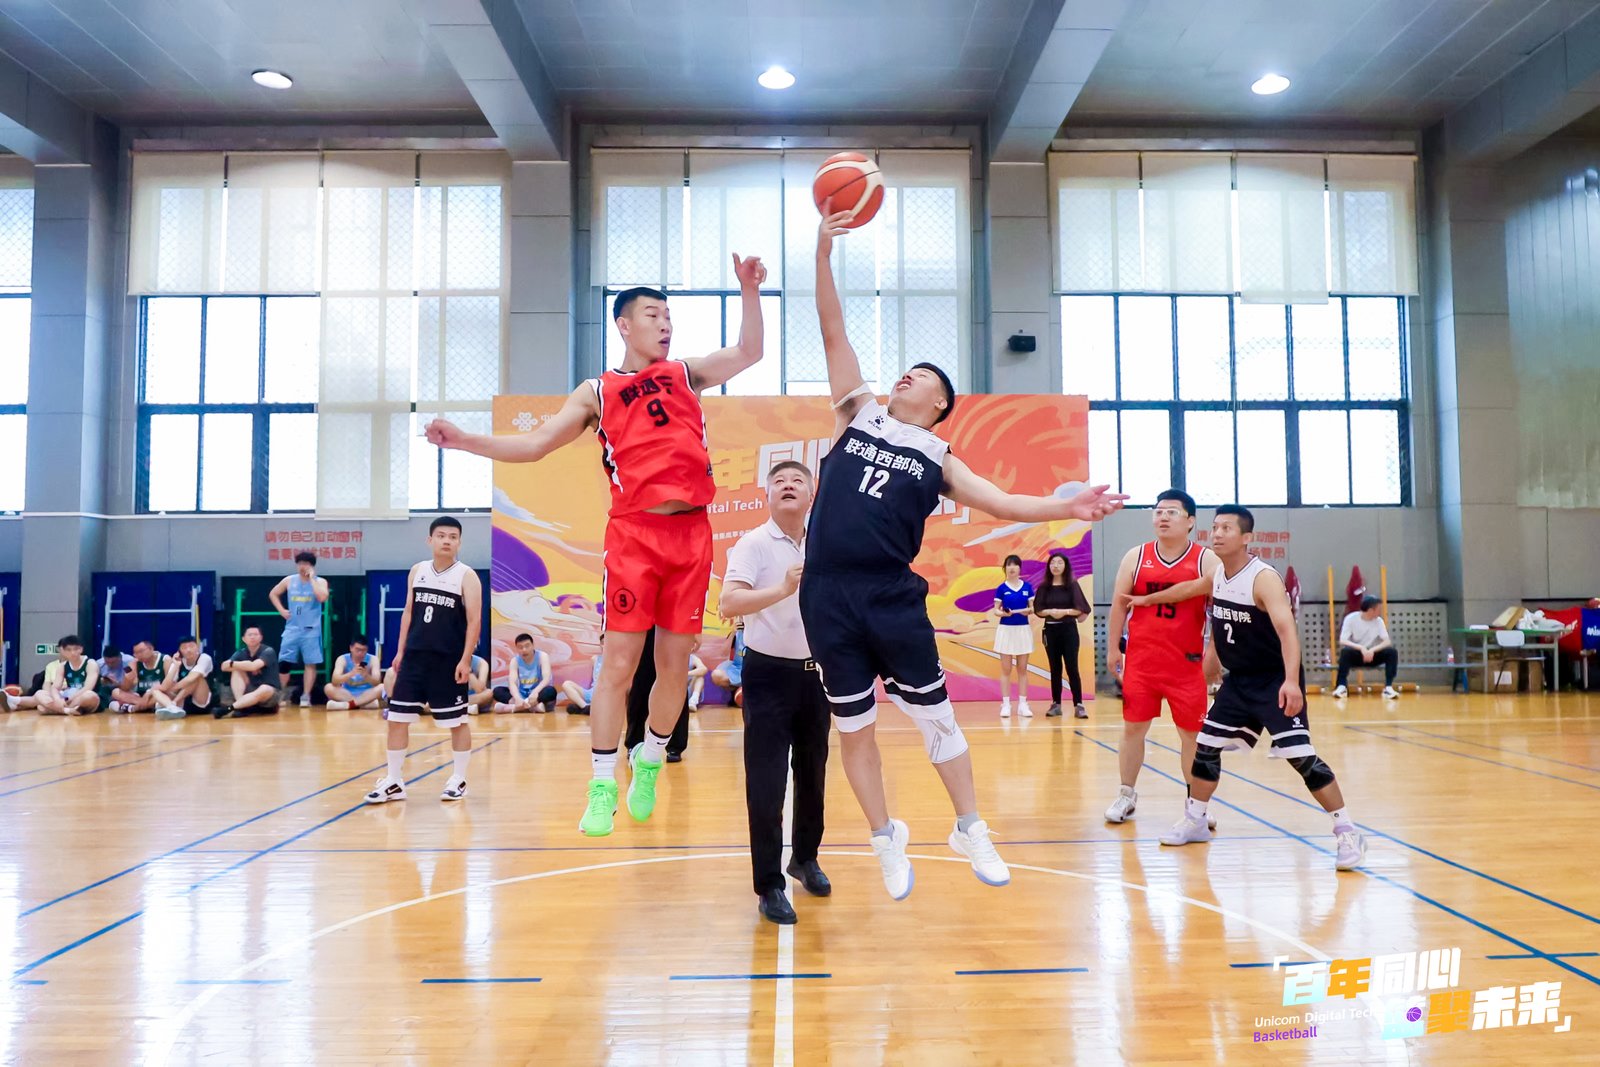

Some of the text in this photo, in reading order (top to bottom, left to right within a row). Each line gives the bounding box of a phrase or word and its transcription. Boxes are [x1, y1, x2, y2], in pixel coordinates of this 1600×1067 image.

[647, 399, 669, 428] 9
[844, 437, 925, 480] 联通西部院
[858, 465, 890, 499] 12
[733, 498, 763, 512] Tech
[619, 594, 628, 608] 9
[1156, 602, 1177, 620] 15
[423, 605, 434, 624] 8
[1223, 622, 1236, 645] 2
